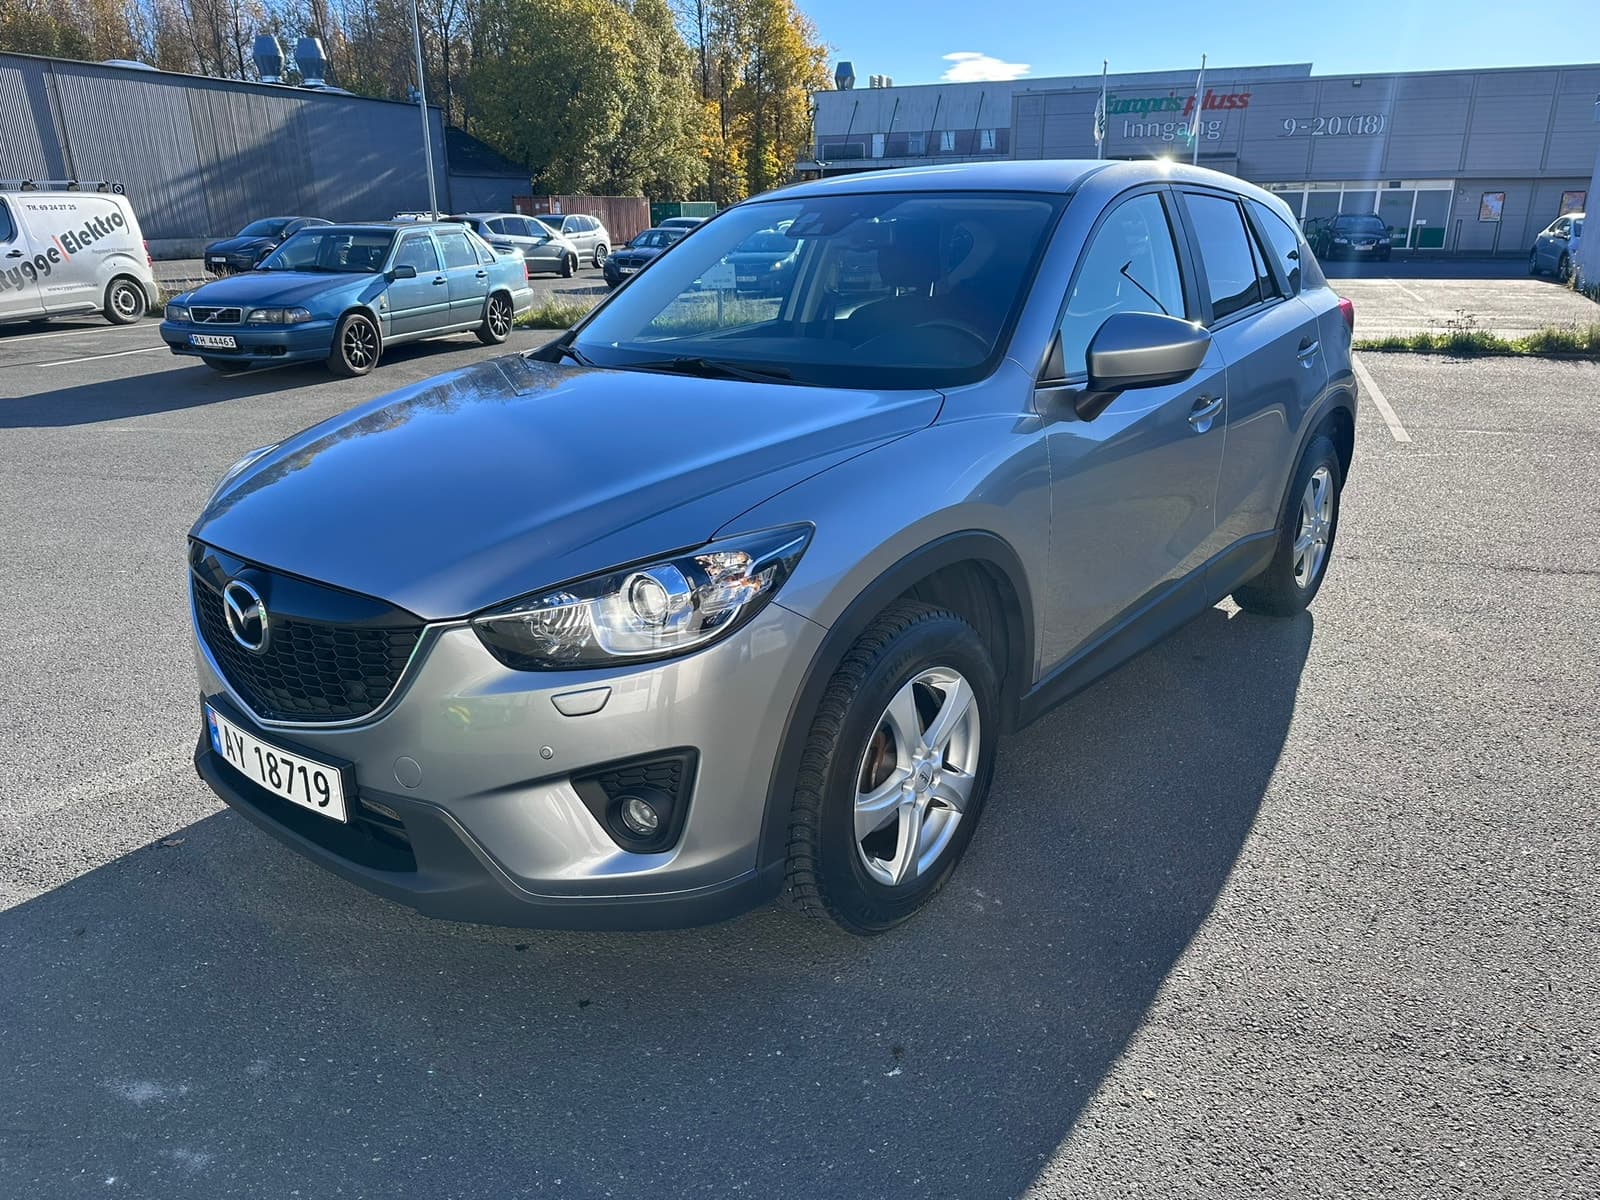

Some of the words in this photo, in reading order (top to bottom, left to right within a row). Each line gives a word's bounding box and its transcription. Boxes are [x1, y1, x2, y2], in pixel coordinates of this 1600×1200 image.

[194, 335, 206, 345] RH
[208, 336, 235, 347] 44465
[224, 725, 245, 768] AY
[254, 746, 330, 808] 18719
